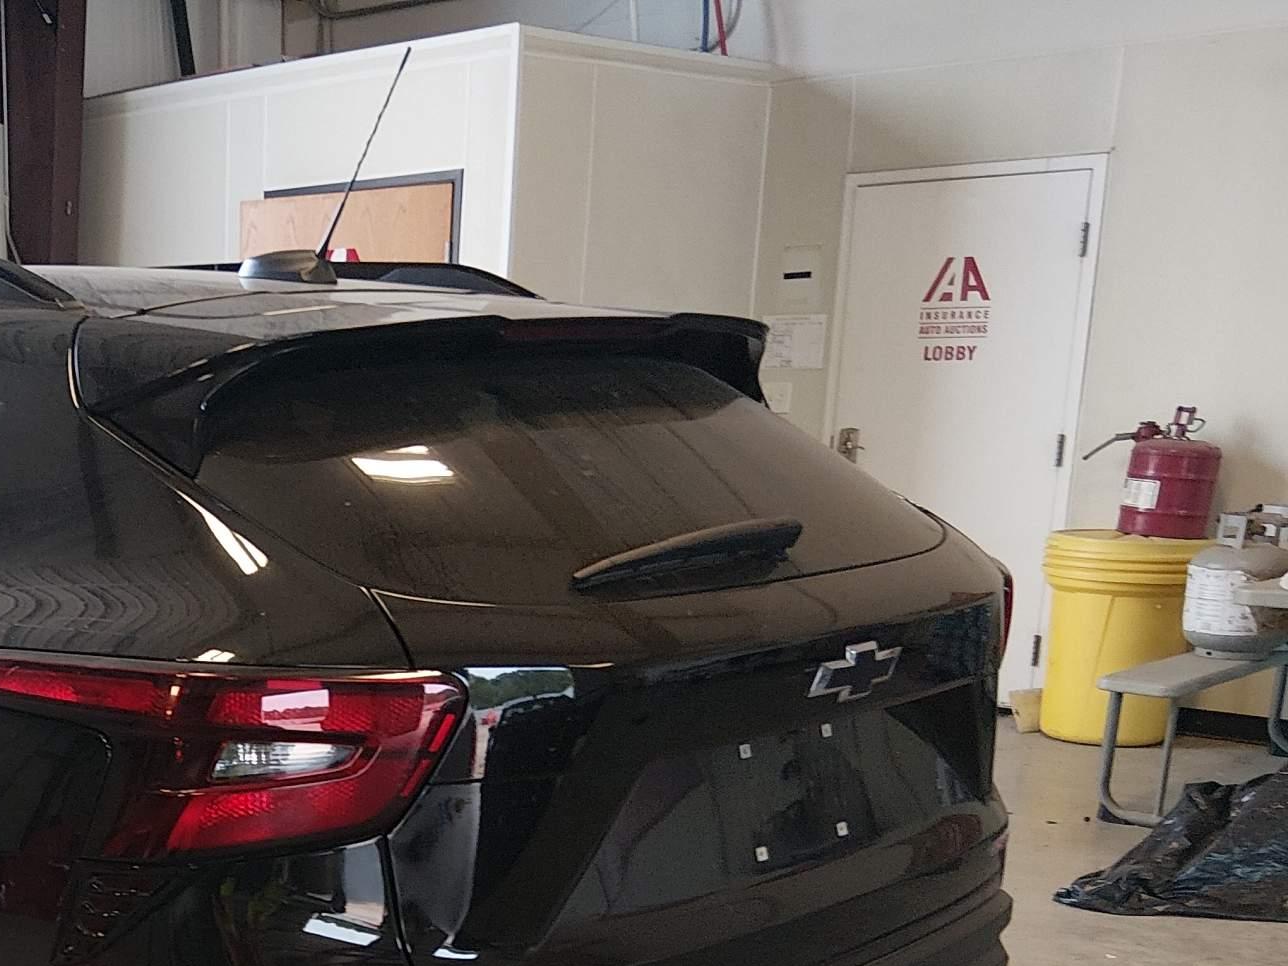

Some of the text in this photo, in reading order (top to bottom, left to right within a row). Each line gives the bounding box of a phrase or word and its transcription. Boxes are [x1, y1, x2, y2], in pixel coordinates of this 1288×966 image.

[920, 310, 990, 320] INSURANCE
[919, 324, 988, 335] AUTO AUCTIONS
[923, 346, 977, 361] LOBBY
